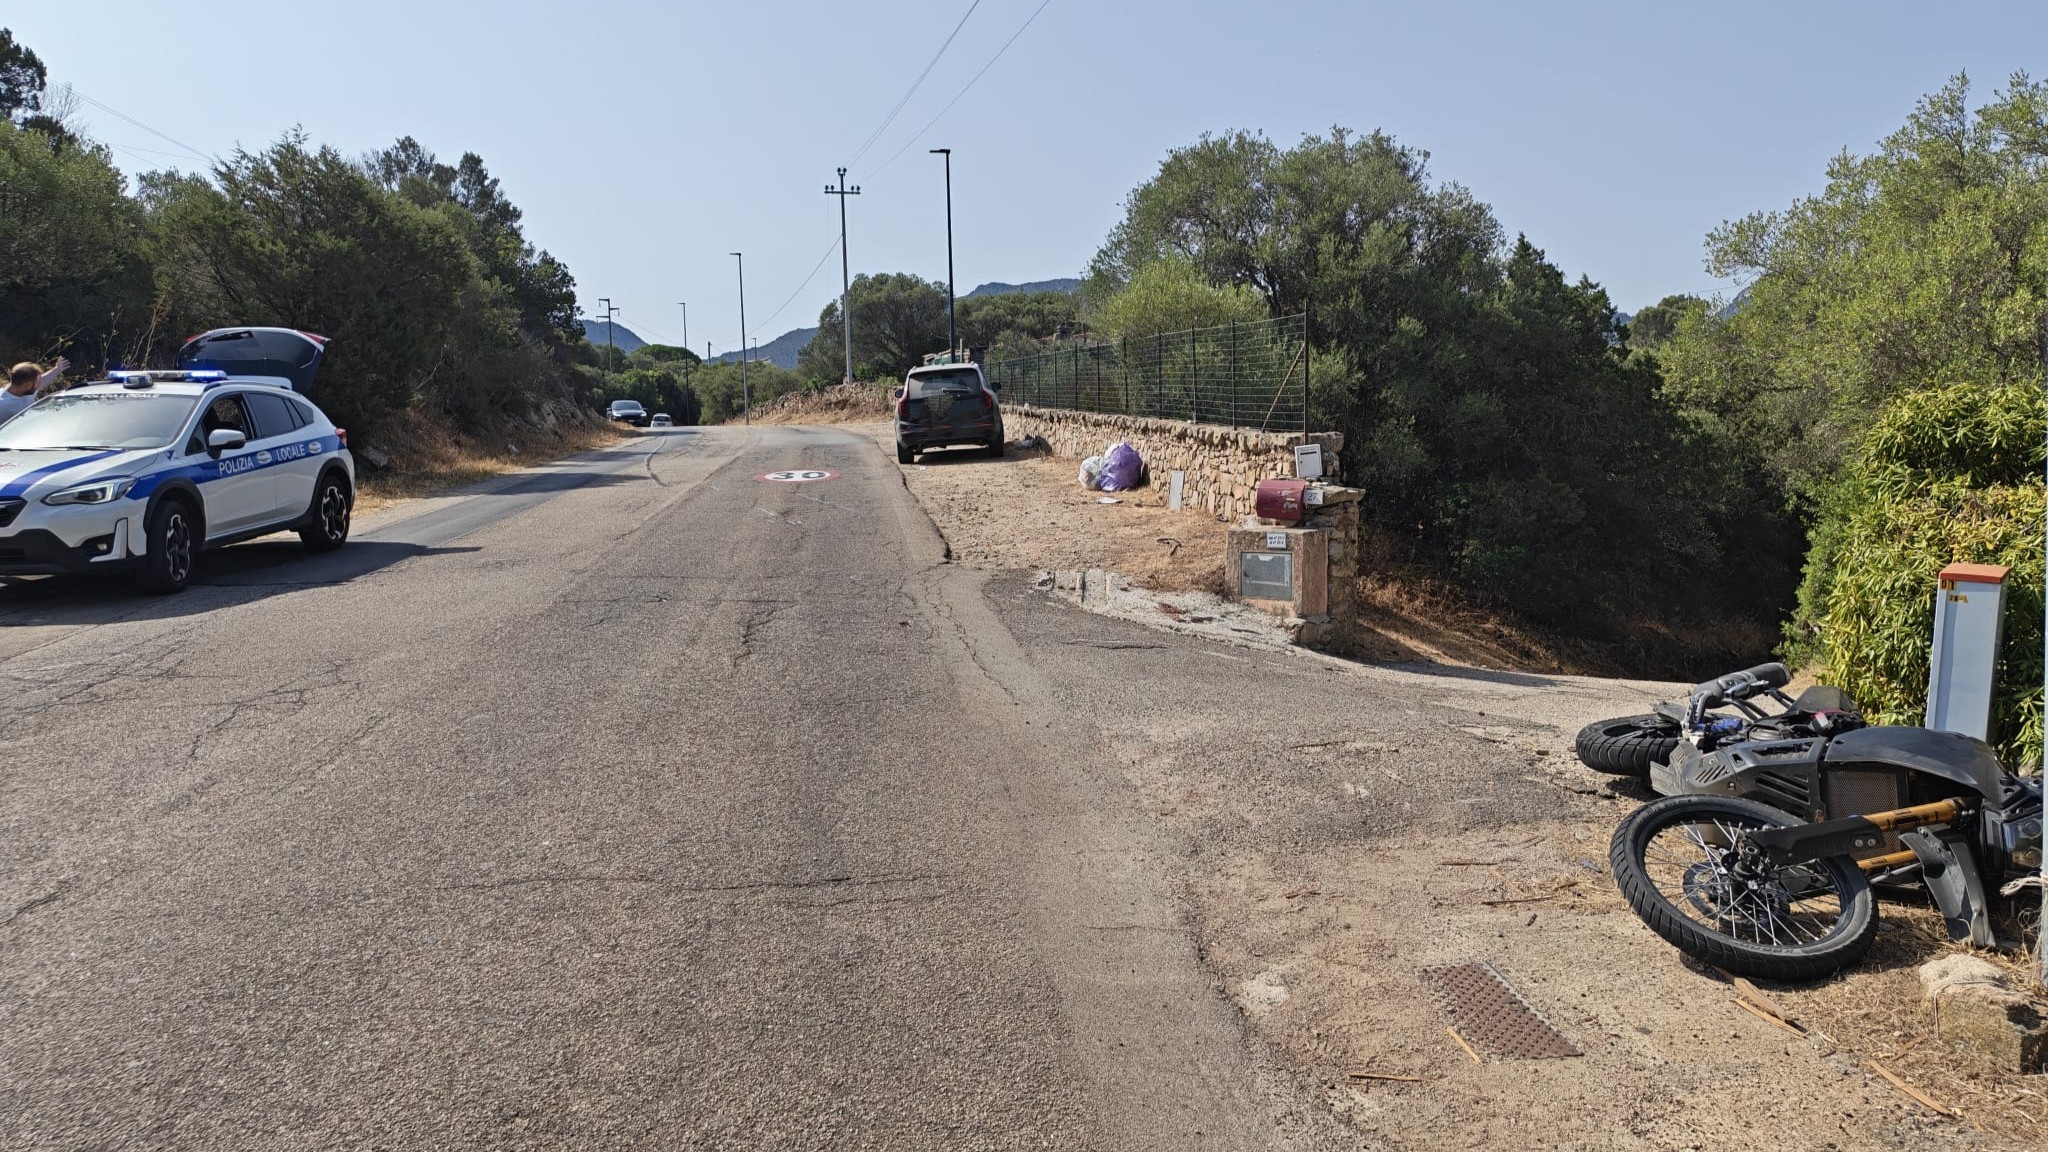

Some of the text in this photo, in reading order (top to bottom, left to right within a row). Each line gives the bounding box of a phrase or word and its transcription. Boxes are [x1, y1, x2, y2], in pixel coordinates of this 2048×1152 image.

[218, 443, 306, 476] POLIZIA LOCALE
[772, 471, 826, 480] 30
